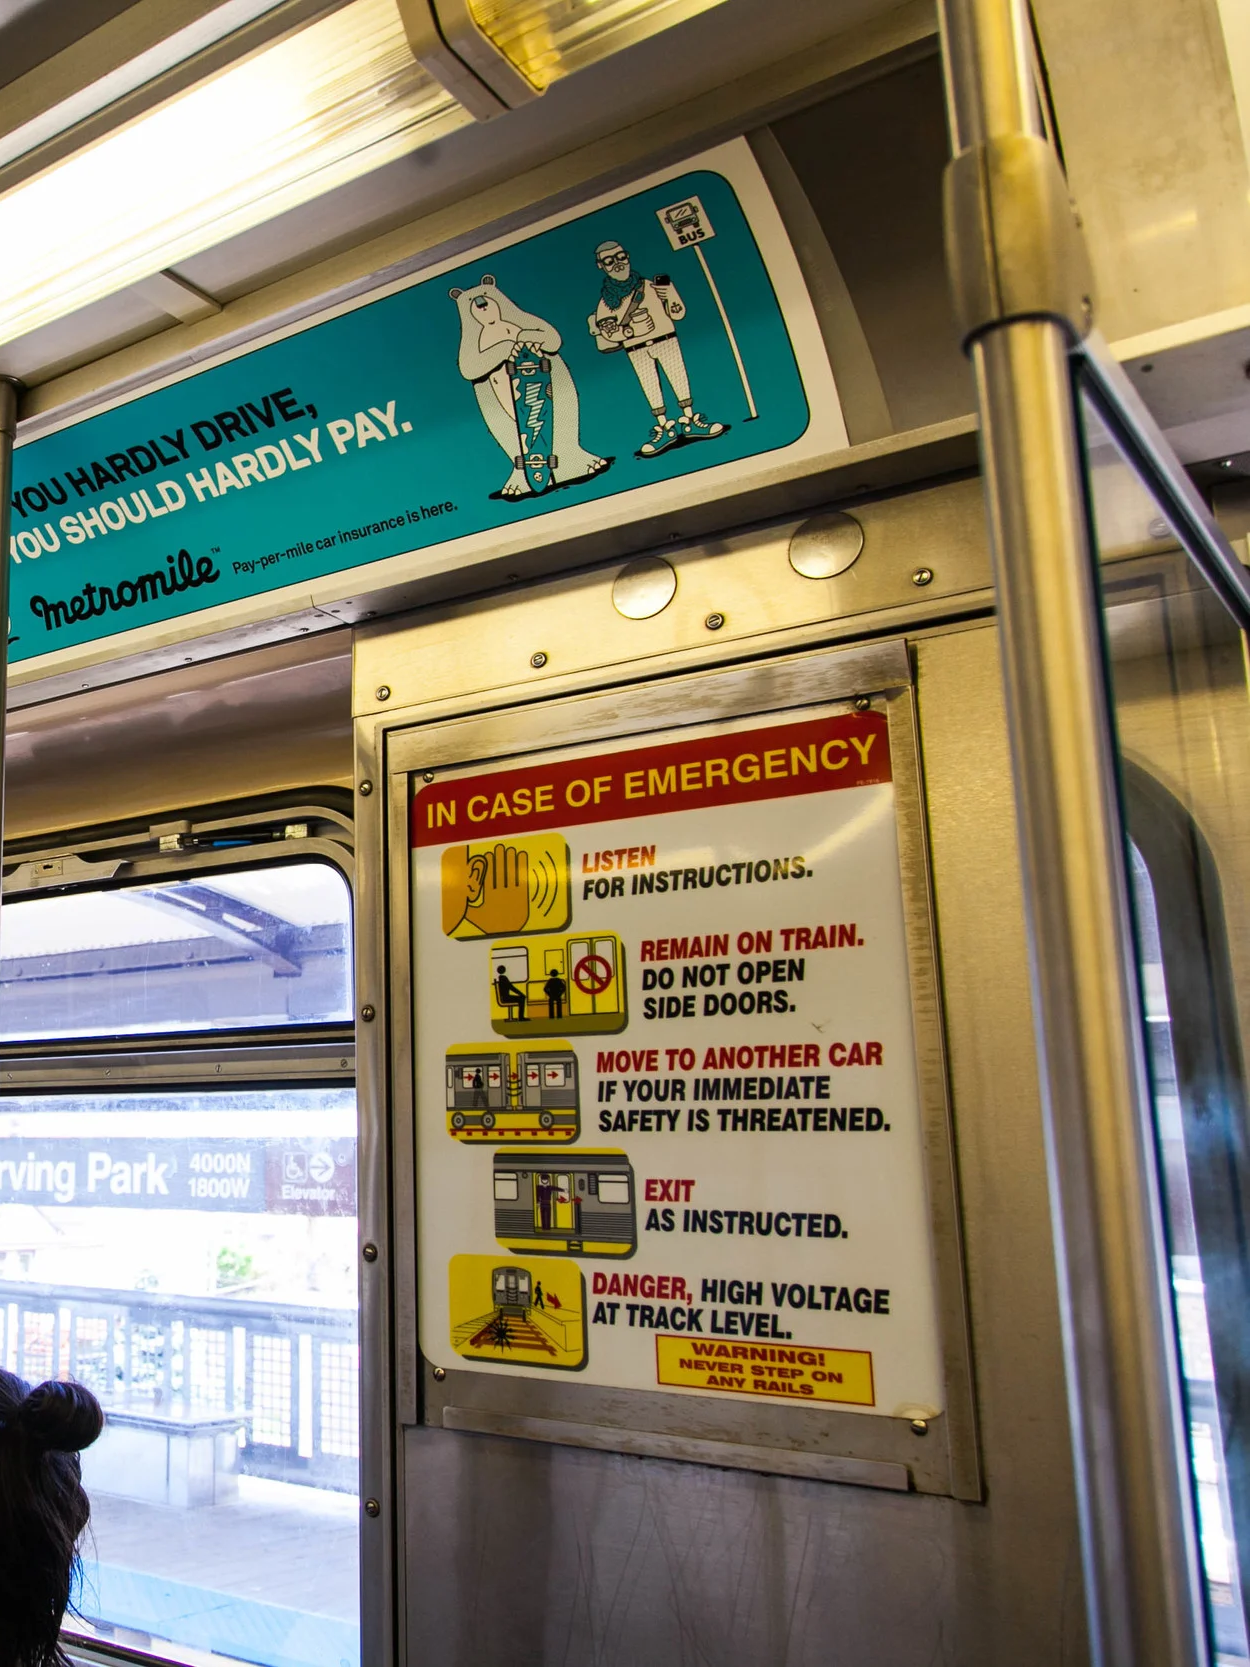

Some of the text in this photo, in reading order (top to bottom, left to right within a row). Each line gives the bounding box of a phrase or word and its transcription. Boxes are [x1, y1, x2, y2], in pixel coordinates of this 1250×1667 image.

[678, 228, 705, 245] BUS
[10, 388, 319, 518] YOU HARDLY DRIVE,
[10, 400, 413, 564] YOU SHOULD HARDLY PAY.
[232, 501, 458, 575] Pay-per-mile car insurance is here.
[427, 733, 877, 829] IN CASE OF EMERGENCY
[582, 845, 656, 874] LISTEN
[583, 856, 813, 900] FOR INSTRUCTIONS.
[641, 923, 864, 962] REMAIN ON TRAIN.
[642, 959, 805, 991] DO NOT OPEN
[643, 990, 795, 1019] SIDE DOORS.
[596, 1042, 883, 1073] MOVE TO ANOTHER CAR
[598, 1075, 830, 1102] IF YOUR IMMEDIATE
[598, 1107, 890, 1132] SAFETY IS THREATENED.
[87, 1152, 169, 1195] Park
[189, 1153, 251, 1173] 4000N
[188, 1177, 251, 1198] 1800W
[281, 1184, 336, 1200] Elevator
[645, 1179, 695, 1202] EXIT
[645, 1209, 848, 1239] AS INSTRUCTED.
[592, 1272, 890, 1315] DANGER, HIGH VOLTAGE
[592, 1302, 792, 1339] AT TRACK LEVEL.
[691, 1342, 826, 1367] WARNING!
[679, 1358, 843, 1384] NEVER STEP ON
[707, 1374, 814, 1395] ANY RAILS
